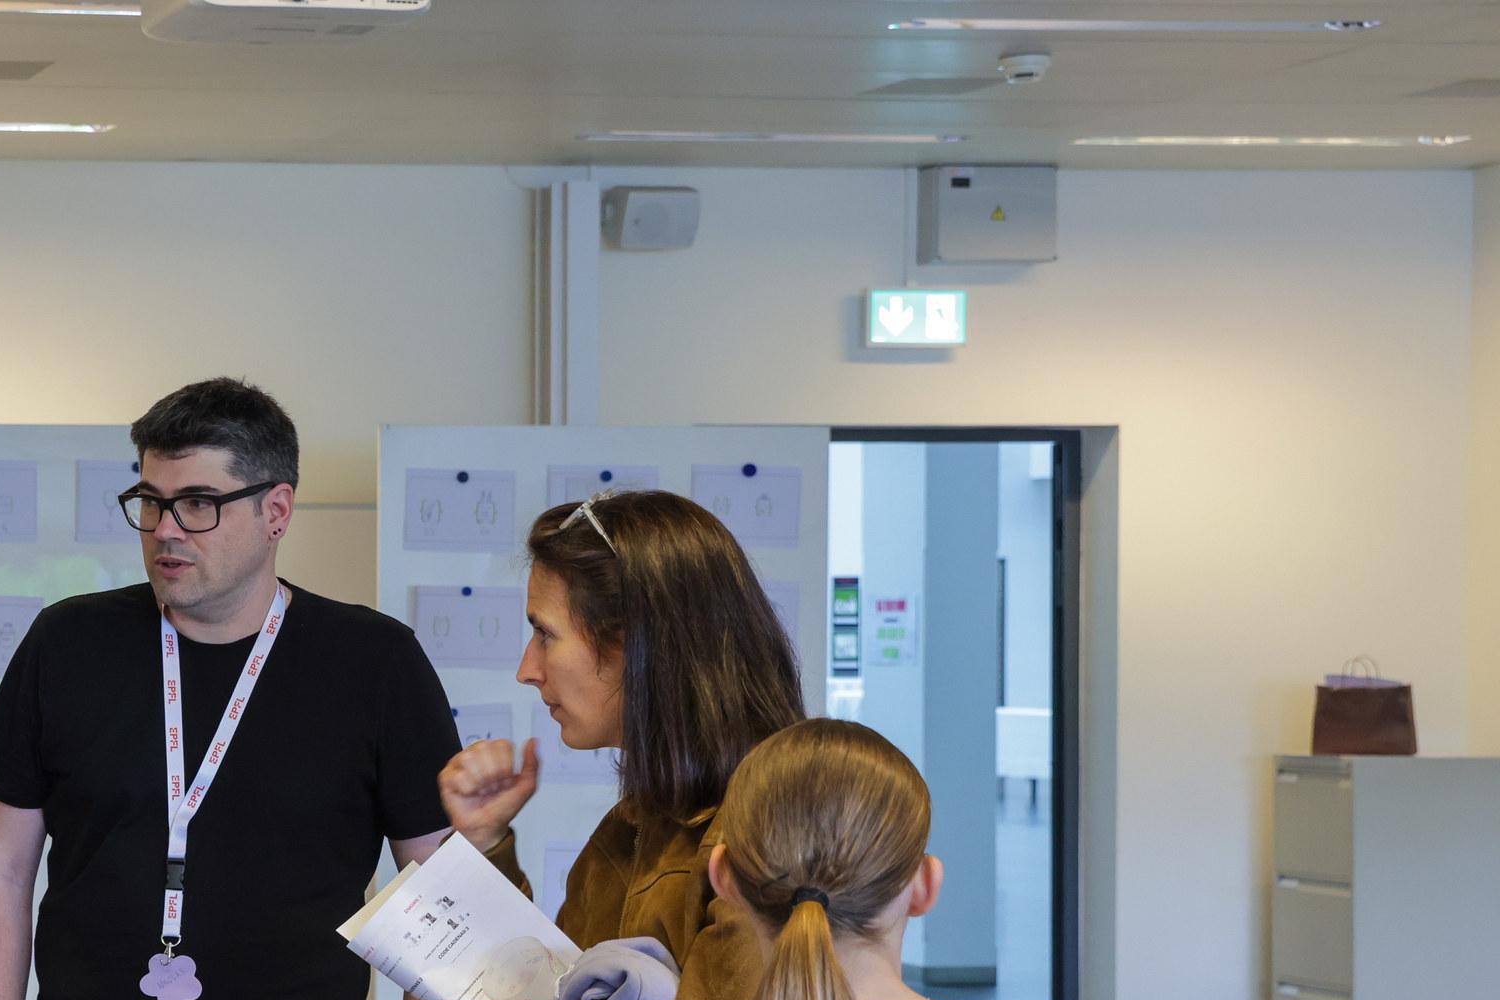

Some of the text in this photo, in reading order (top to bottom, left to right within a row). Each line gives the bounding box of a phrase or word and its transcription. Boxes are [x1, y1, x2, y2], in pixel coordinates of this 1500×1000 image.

[266, 613, 281, 636] EPFL
[164, 634, 174, 658] EPFL
[247, 653, 264, 677] EPFL
[167, 680, 177, 704] EPFL
[229, 696, 245, 720] EPFL
[169, 727, 178, 752] EPFL
[209, 740, 226, 765] EPFL
[171, 775, 181, 801] EPFL
[187, 784, 206, 809] EPFL
[168, 893, 178, 919] EPFL
[438, 947, 450, 960] CODE
